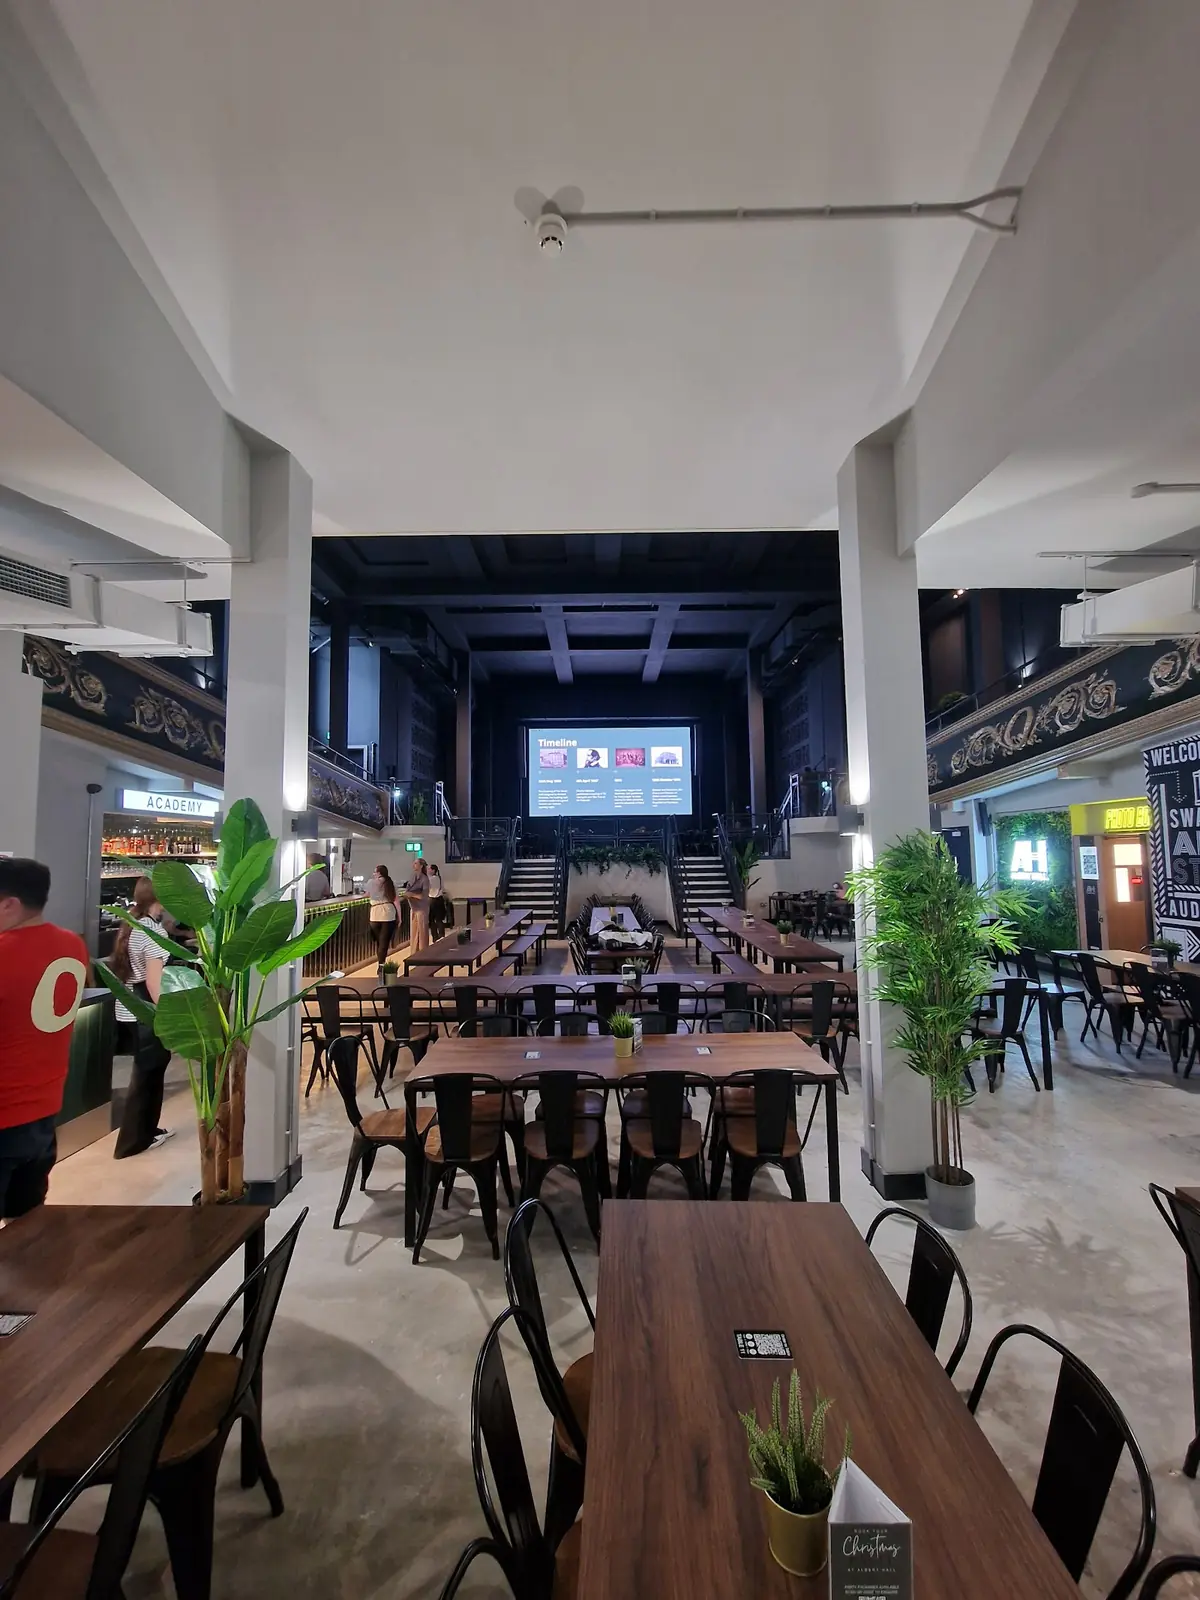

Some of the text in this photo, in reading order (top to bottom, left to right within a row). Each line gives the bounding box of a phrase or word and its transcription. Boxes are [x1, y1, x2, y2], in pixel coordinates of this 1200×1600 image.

[538, 739, 577, 747] Timeline
[1150, 741, 1200, 767] WELCO
[146, 796, 203, 812] ACADEMY
[1105, 807, 1135, 829] PHOTO
[1011, 840, 1047, 872] AH
[842, 1533, 901, 1558] Christmas
